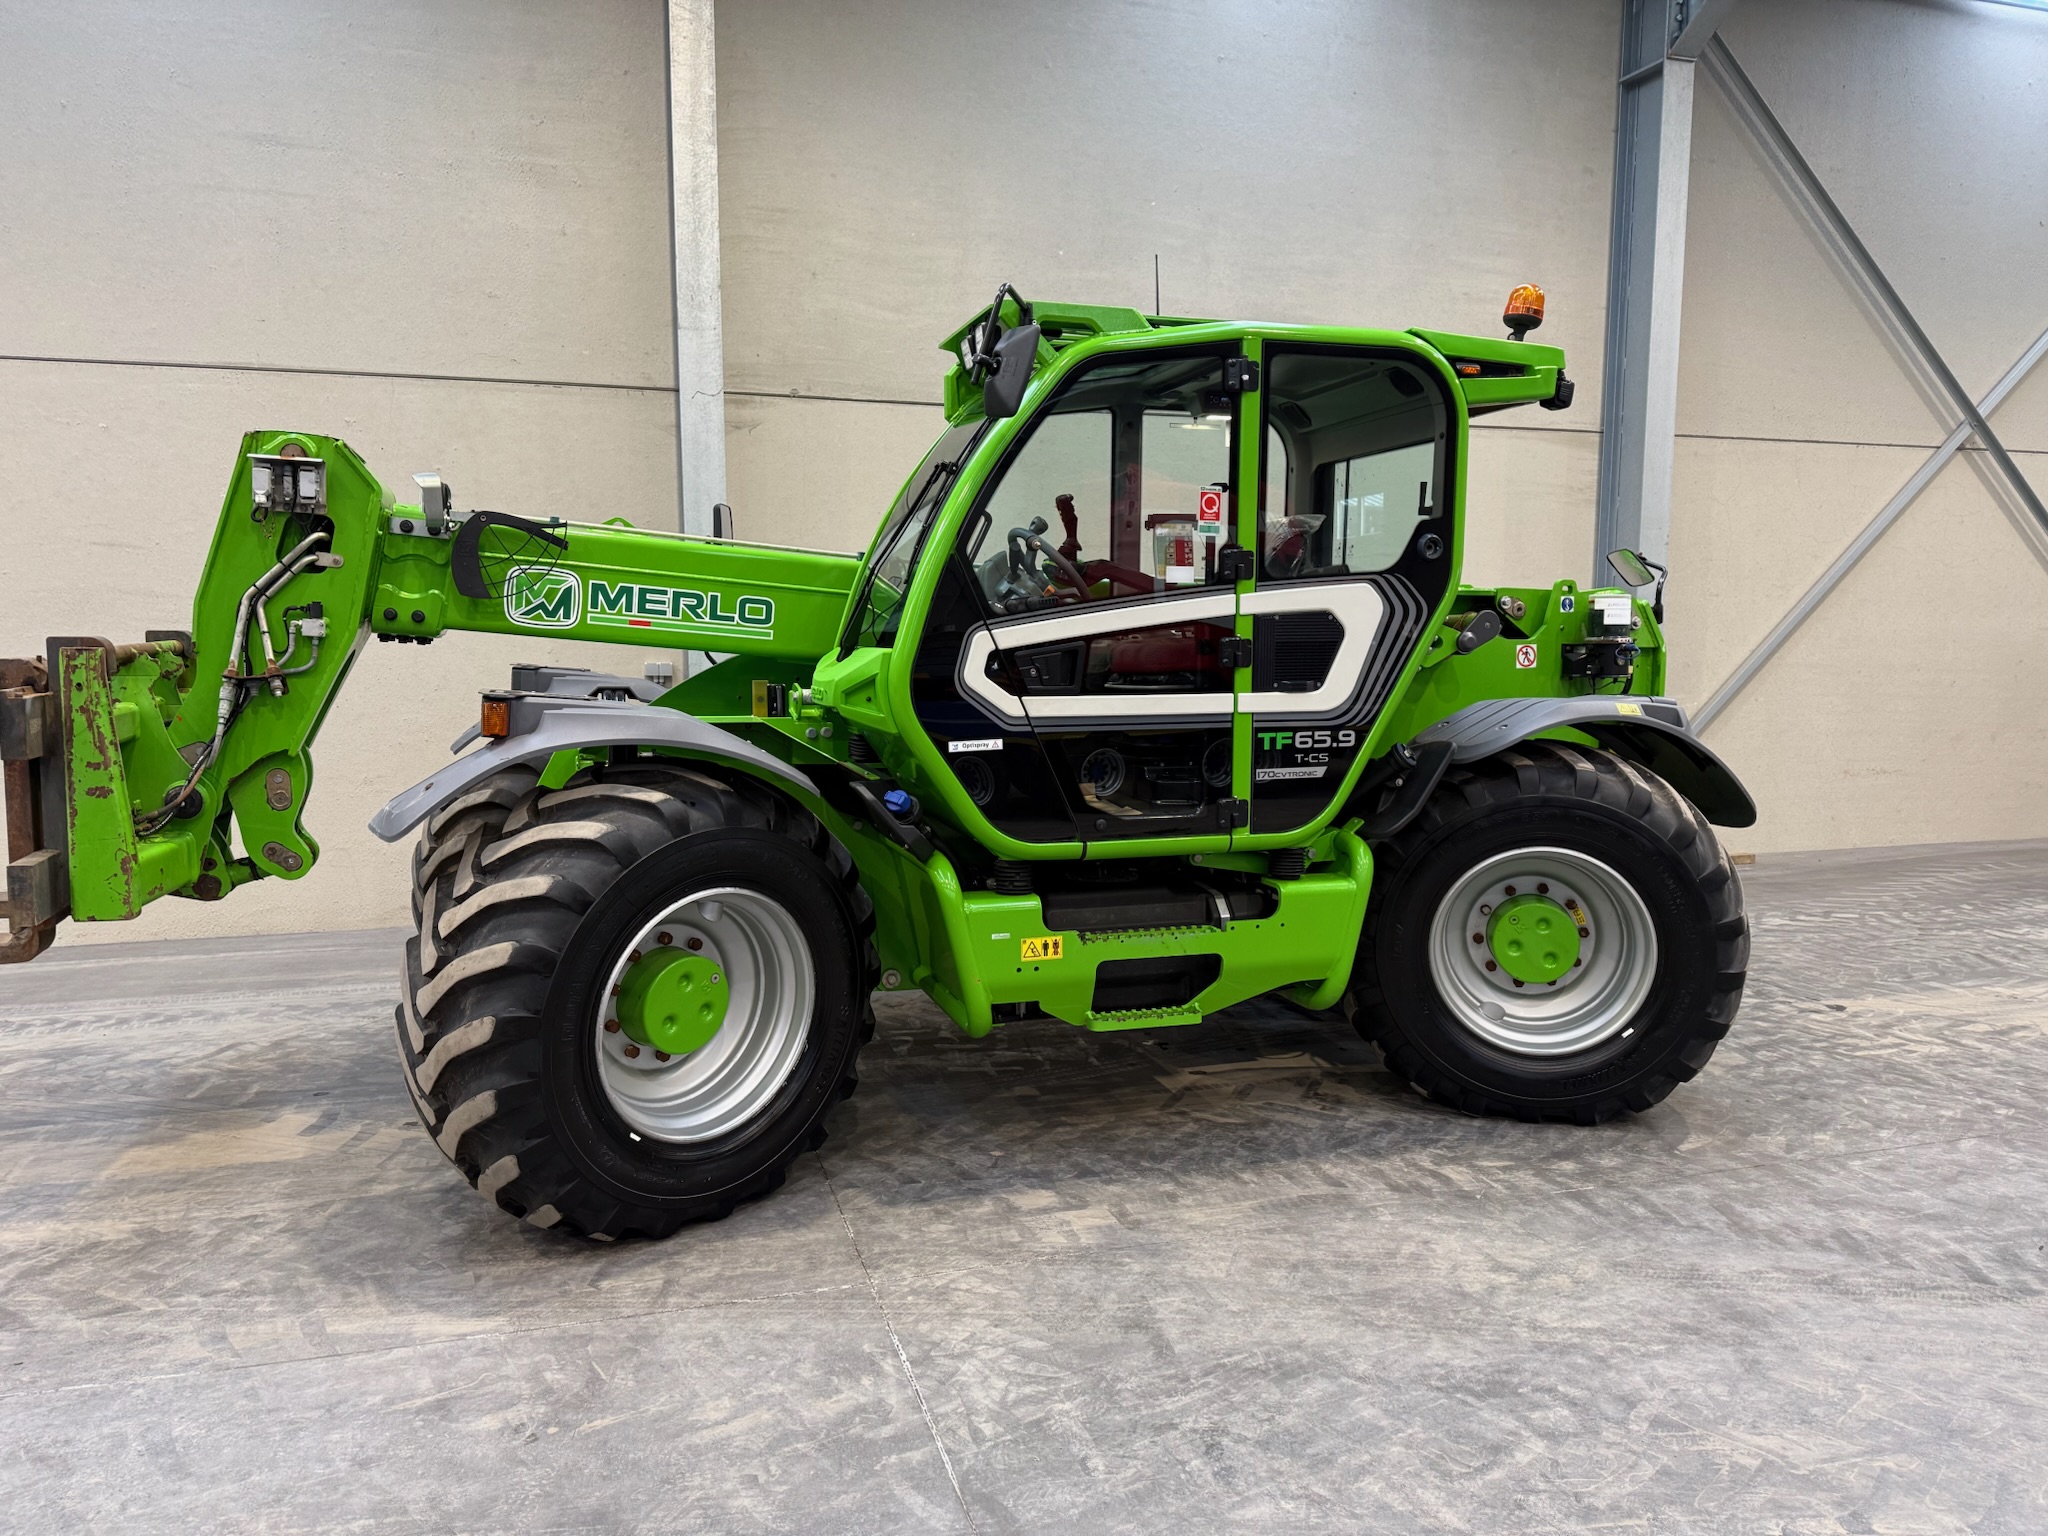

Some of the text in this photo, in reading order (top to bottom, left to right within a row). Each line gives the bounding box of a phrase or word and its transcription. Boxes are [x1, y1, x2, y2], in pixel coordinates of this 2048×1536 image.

[588, 579, 775, 627] MERLO
[962, 742, 990, 750] Optispray
[1257, 730, 1356, 750] TF65.9
[1295, 753, 1329, 763] T-CS
